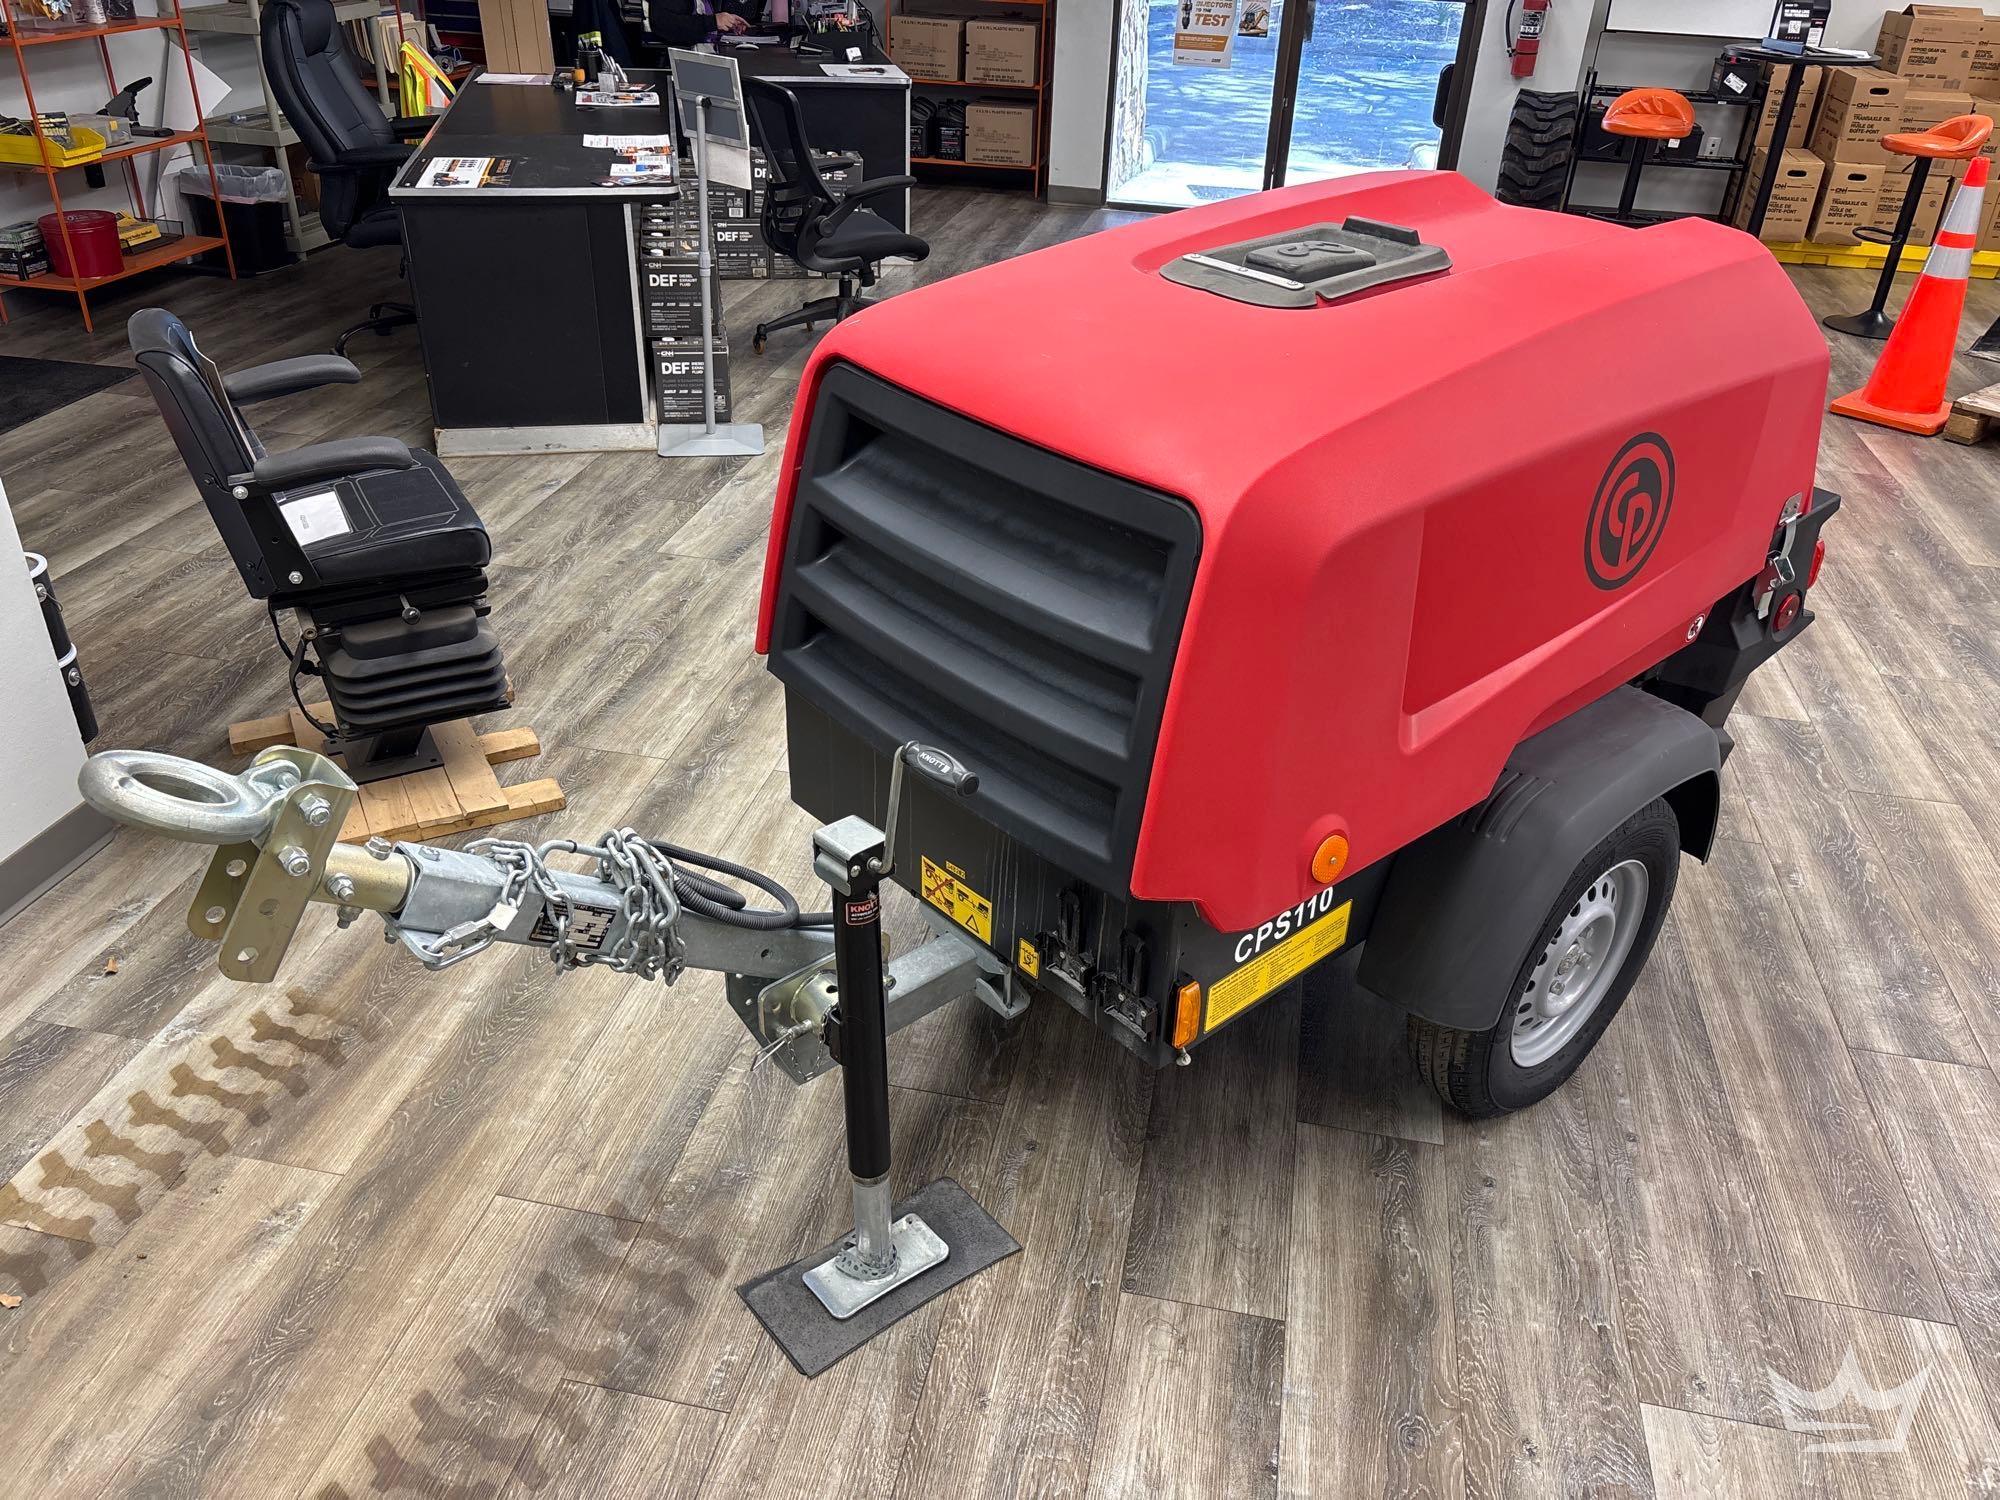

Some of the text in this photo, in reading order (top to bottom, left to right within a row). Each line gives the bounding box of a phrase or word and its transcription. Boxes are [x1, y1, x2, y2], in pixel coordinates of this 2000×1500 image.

[1194, 13, 1230, 27] TEST
[1856, 101, 1870, 109] CNH
[1774, 182, 1787, 190] CNH
[1771, 194, 1799, 202] TRANSAXLE
[716, 231, 739, 242] DEF
[648, 273, 678, 287] DEF
[661, 361, 690, 375] DEF
[919, 751, 946, 768] KNOTT
[1234, 886, 1334, 964] CPS110
